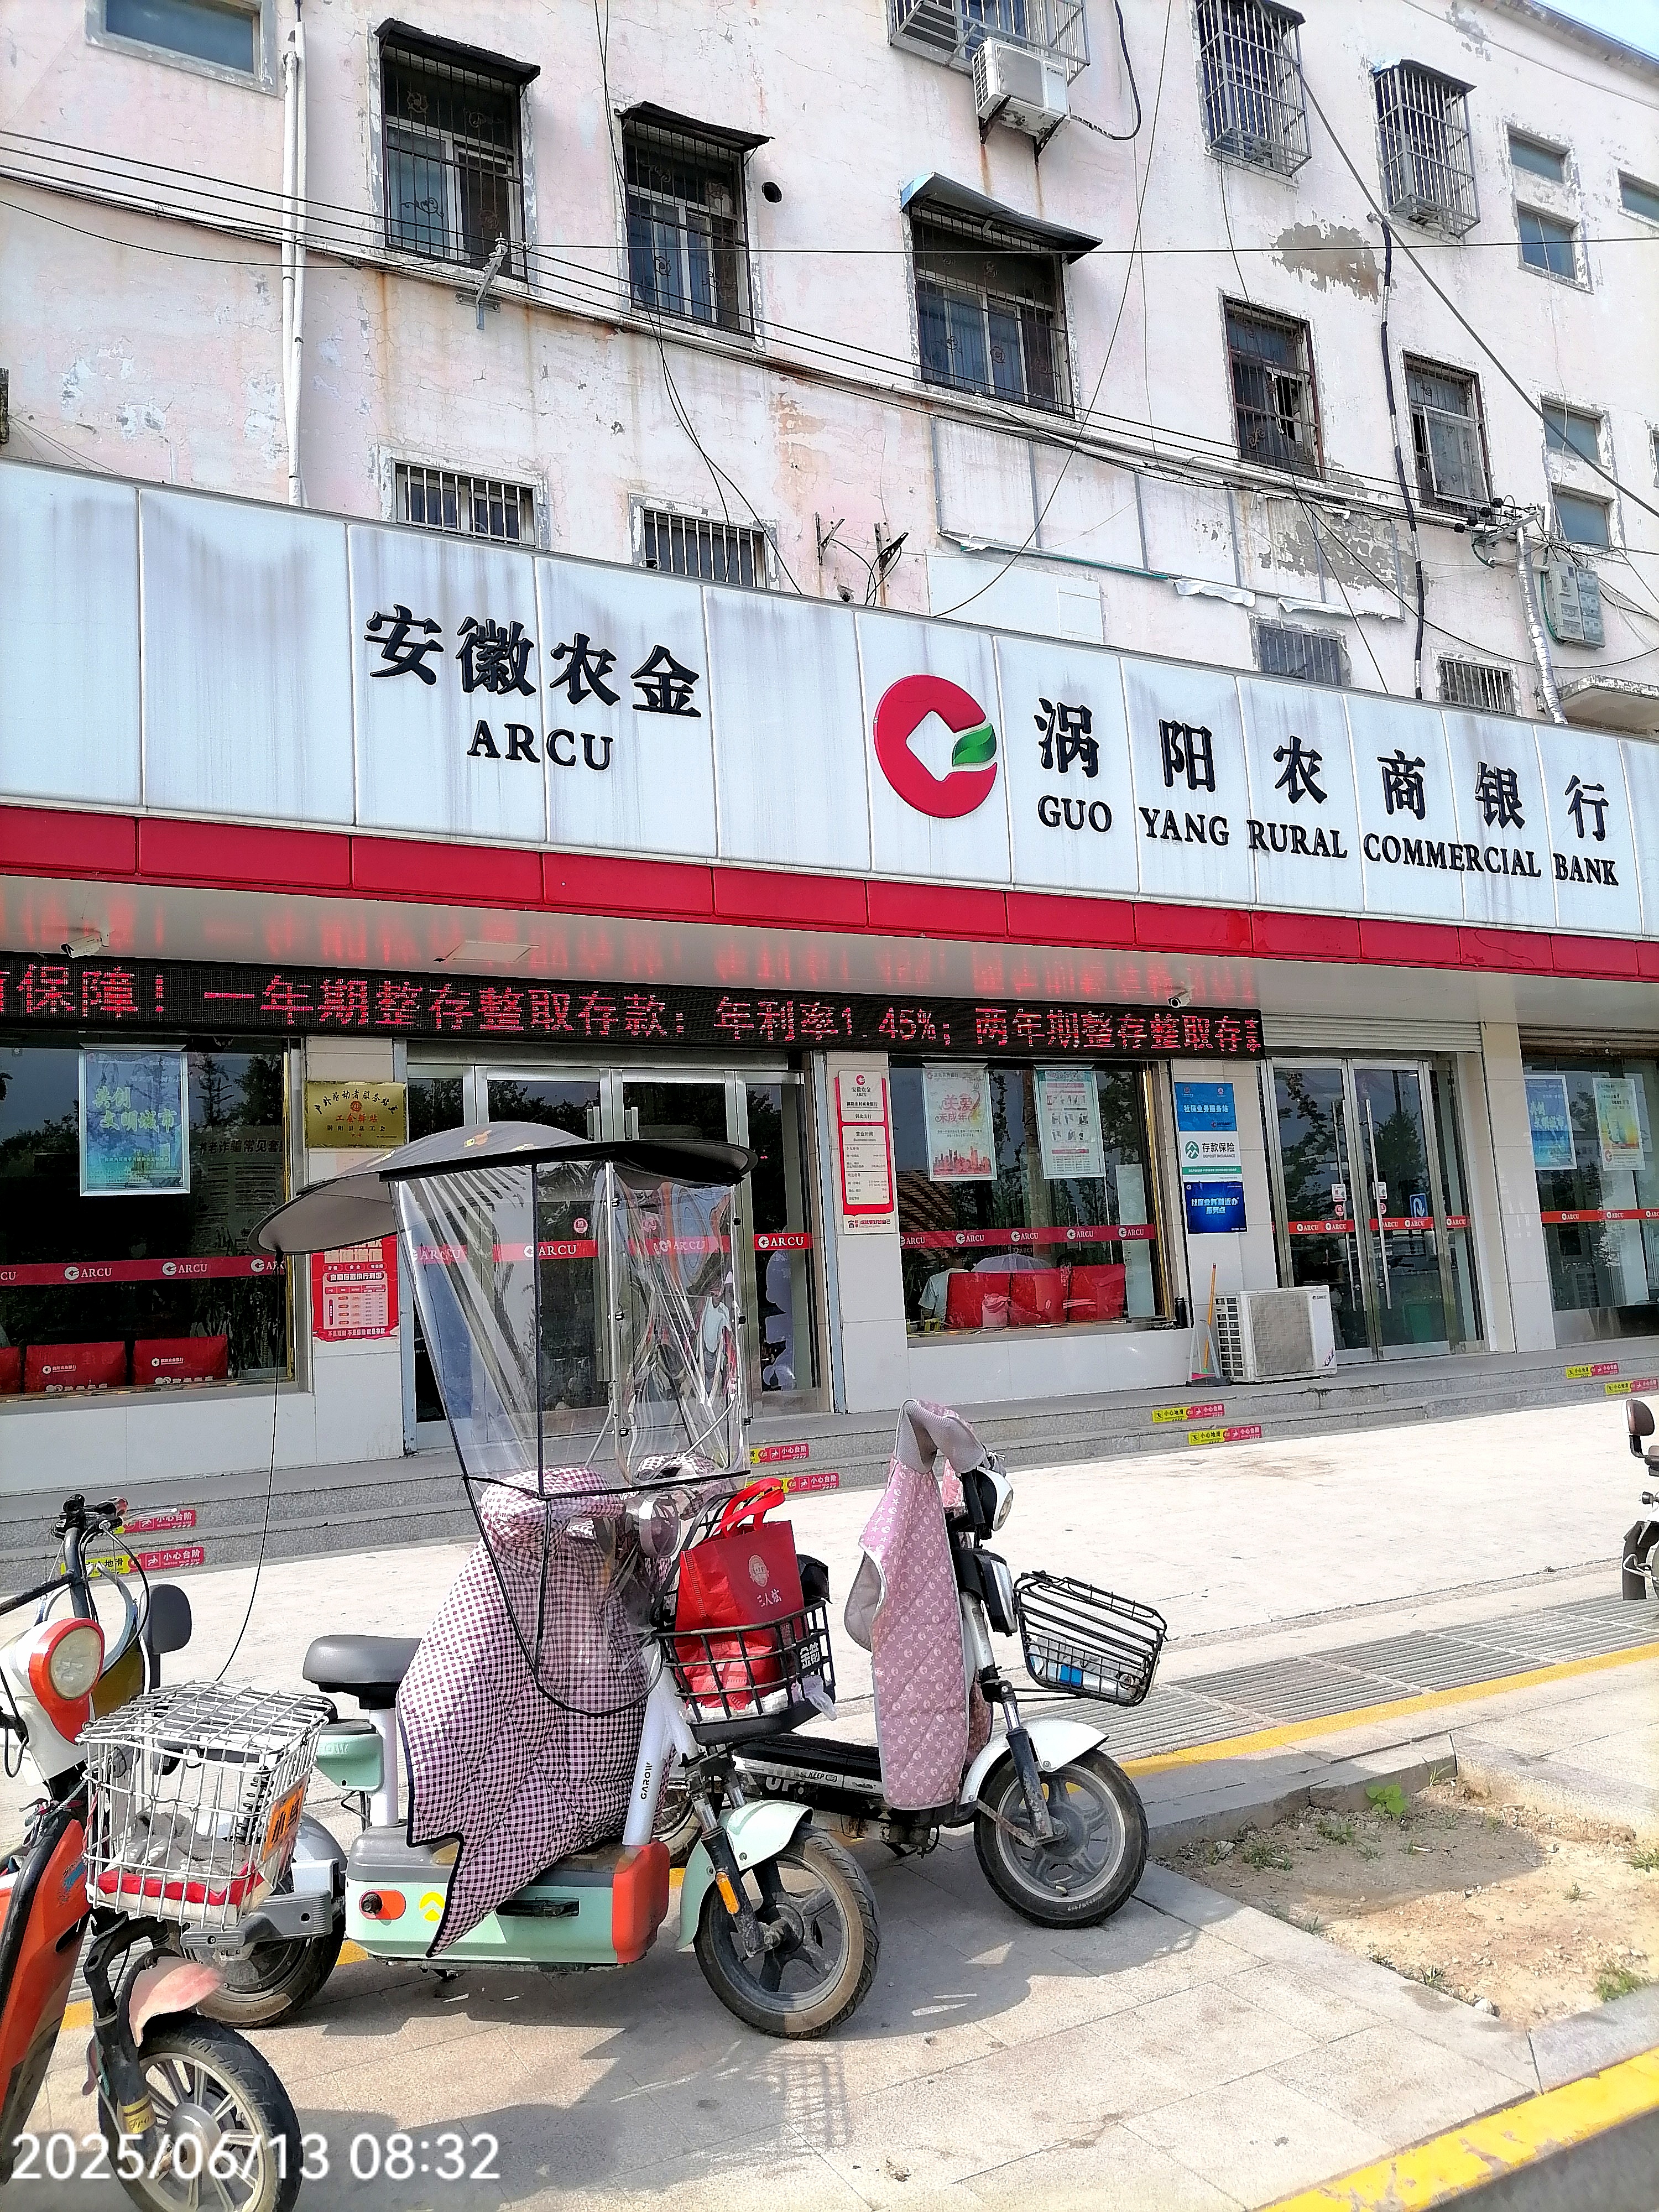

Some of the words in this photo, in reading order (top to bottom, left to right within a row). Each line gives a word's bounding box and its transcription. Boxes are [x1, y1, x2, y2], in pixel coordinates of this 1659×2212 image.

[364, 604, 701, 718] 安徽农金
[467, 720, 613, 771] ARCU
[1034, 697, 1609, 842] 涡阳农商银行
[1037, 795, 1113, 833] GUO
[1139, 806, 1229, 847] YANG
[1247, 818, 1348, 858] RURAL
[1363, 833, 1542, 878] COMMERCIAL
[1553, 853, 1619, 886] BANK
[1202, 1142, 1235, 1152] 存款保险
[906, 1237, 925, 1245] ARCU
[966, 1234, 985, 1243] ARCU
[1021, 1232, 1039, 1240] ARCU
[1076, 1230, 1094, 1239] ARCU
[1127, 1228, 1144, 1237] ARCU
[539, 1244, 577, 1258] ARCU
[770, 1236, 805, 1248] ARCU
[81, 1267, 112, 1278] ARCU
[178, 1263, 208, 1274] ARCU
[781, 1445, 807, 1455] 小心台阶
[811, 1474, 837, 1484] 小心台阶
[156, 1511, 192, 1523] 小心台阶
[163, 1549, 201, 1561] 小心台阶
[800, 1642, 820, 1670] 金箭
[808, 1771, 825, 1780] KEEP
